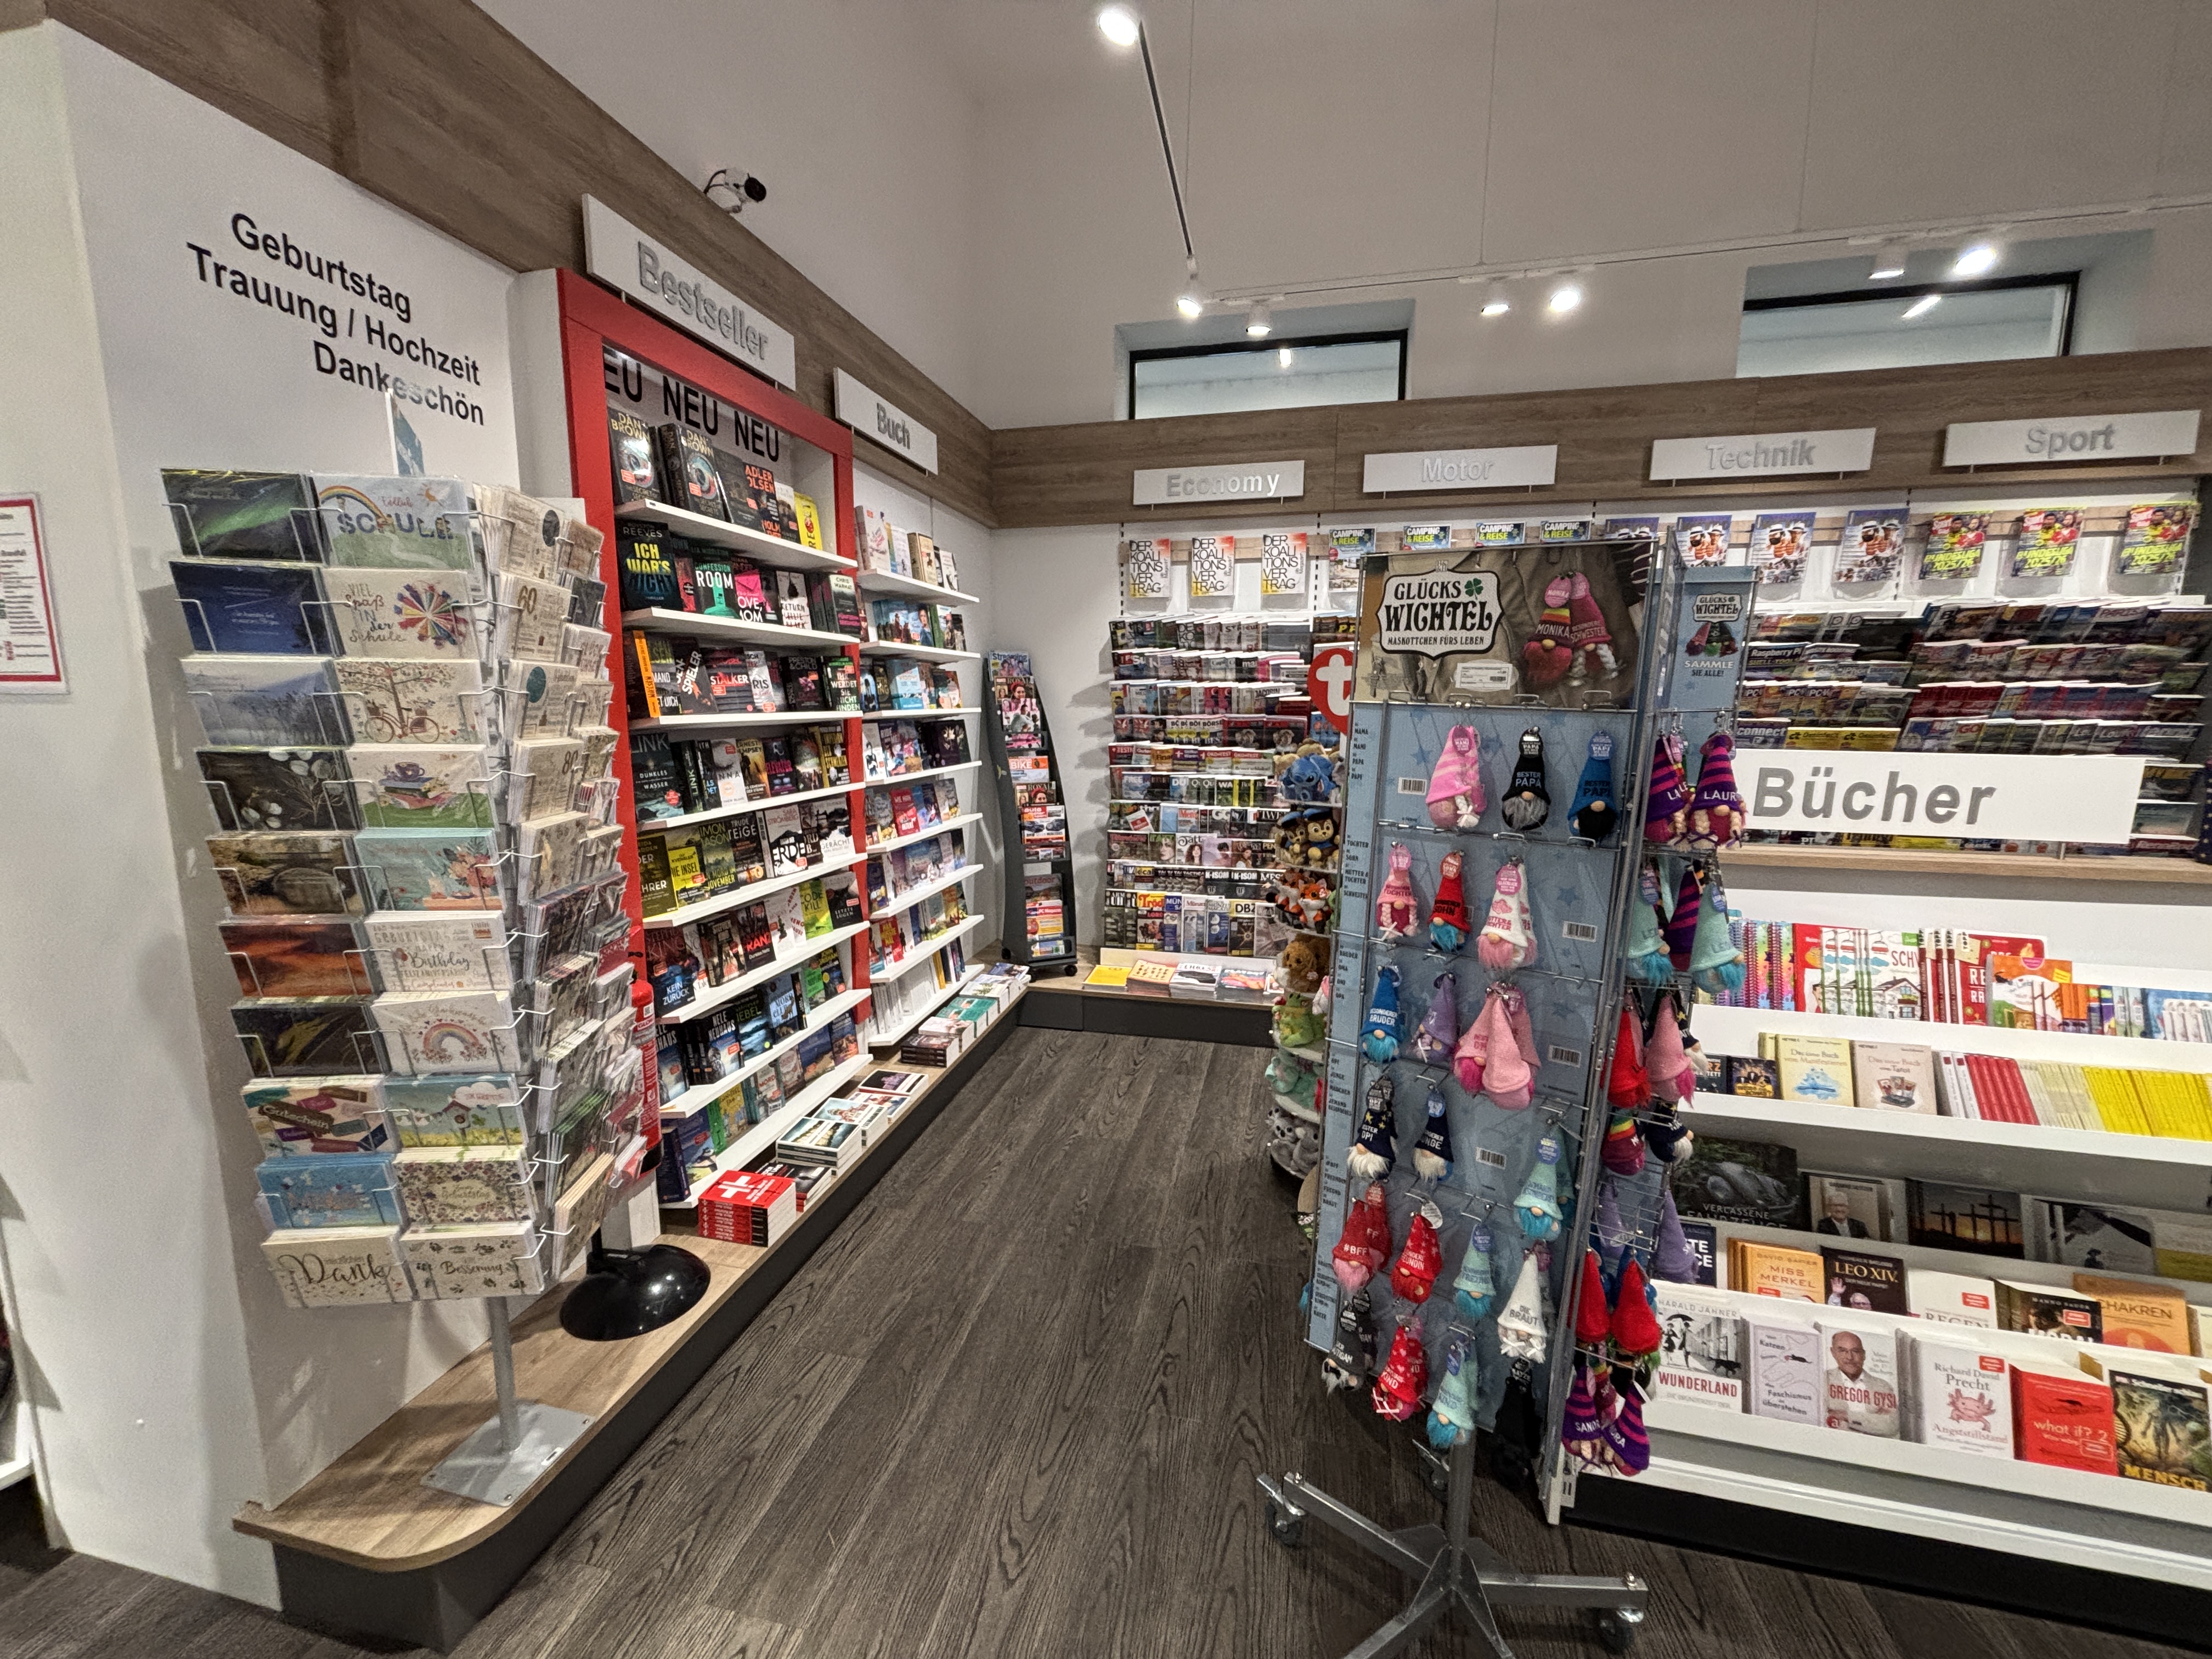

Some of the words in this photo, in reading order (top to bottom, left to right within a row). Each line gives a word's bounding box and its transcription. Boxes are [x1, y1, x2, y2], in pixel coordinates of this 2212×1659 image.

[232, 213, 411, 323] Geburtstag
[637, 238, 768, 360] Bestseller
[185, 242, 338, 338] Trauung
[347, 308, 356, 337] /
[365, 314, 480, 386] Hochzeit
[314, 340, 485, 426] Dankeschön
[618, 412, 641, 429] DAN
[663, 375, 719, 436] NEU
[734, 410, 779, 462] NEU
[611, 419, 651, 441] BROWN
[876, 402, 911, 450] Buch
[686, 430, 706, 445] DAN
[2024, 422, 2114, 456] Sport
[1705, 439, 1815, 472] Technik
[745, 465, 773, 484] ADLER
[1421, 457, 1494, 483] Motor
[1166, 472, 1280, 498] Economy
[623, 527, 663, 538] REEVES
[1407, 526, 1440, 536] CAMPING
[1479, 524, 1514, 534] CAMPING
[1544, 522, 1579, 531] CAMPING
[1333, 529, 1365, 538] CAMPING
[1413, 534, 1435, 543] REISE
[1486, 532, 1508, 540] REISE
[1551, 529, 1573, 538] REISE
[1130, 540, 1152, 551] DER
[1193, 538, 1216, 549] DER
[1263, 535, 1288, 546] DER
[1339, 537, 1359, 545] REISE
[634, 543, 660, 559] ICH
[1925, 549, 1980, 561] BUNDESLIGA
[2016, 546, 2074, 560] BUNDESLIGA
[2121, 543, 2182, 558] BUNDESLIGA
[627, 558, 672, 575] WAR'S
[1131, 561, 1163, 573] TIONS
[1193, 559, 1227, 571] TIONS
[1264, 556, 1299, 568] TIONS
[696, 570, 733, 590] ROOM
[1131, 573, 1153, 583] VER
[1193, 571, 1216, 582] VER
[1264, 568, 1287, 579] VER
[1131, 582, 1161, 594] TRAG
[1193, 580, 1224, 591] TRAG
[1263, 578, 1296, 589] TRAG
[1394, 578, 1462, 601] GLÜCKS
[345, 595, 385, 611] Spaß
[518, 585, 538, 614] 60
[1696, 604, 1739, 614] WICHTEL
[359, 610, 376, 623] IN
[1385, 601, 1493, 632] WICHTEL
[370, 622, 394, 633] der
[1537, 623, 1570, 638] MONIKA
[1570, 625, 1607, 643] SCHWESTER
[350, 628, 408, 642] Schule
[1387, 636, 1437, 646] MASKOTTCHEN
[1440, 635, 1458, 646] FÜRS
[1460, 636, 1485, 646] LEBEN
[992, 653, 1028, 663] Streaming
[1751, 648, 1793, 657] Raspberry
[1684, 660, 1734, 669] SAMMLE
[682, 651, 703, 695] SPIELER
[710, 674, 750, 686] STALKER
[831, 680, 857, 689] WERDET
[1737, 726, 1786, 737] connect
[1011, 761, 1032, 770] BIKE
[640, 769, 668, 779] DUNKLES
[644, 781, 669, 790] WASSER
[687, 769, 699, 797] LINK
[1515, 778, 1542, 788] PAPA
[1704, 790, 1737, 801] LAUR
[1753, 766, 1996, 826] Bücher
[731, 817, 749, 828] TRUDE
[1347, 840, 1369, 848] TOCHTER
[682, 862, 698, 876] INSEL
[1024, 877, 1056, 885] outdoor
[1384, 888, 1413, 898] TOCHTER
[805, 902, 820, 912] KILL
[1433, 906, 1457, 916] SOHN
[408, 951, 471, 972] Birthday
[667, 981, 684, 994] KEIN
[663, 988, 690, 1006] ZURÜCK
[713, 1010, 727, 1026] NELE
[1369, 1014, 1396, 1026] BRUDER
[708, 1020, 736, 1041] NEUHAUS
[1821, 1050, 1839, 1059] Buch
[1892, 1065, 1910, 1074] Tarot
[262, 1105, 331, 1130] Gutschein
[1361, 1131, 1373, 1142] OPI
[1703, 1202, 1770, 1220] VERLASSENE
[1344, 1243, 1368, 1256] #BFF
[277, 1252, 391, 1285] Dank
[442, 1261, 504, 1277] Besserung
[1769, 1265, 1805, 1277] MISS
[1835, 1261, 1867, 1278] LEO
[1870, 1265, 1899, 1284] XIV.
[1760, 1273, 1817, 1289] MERKEL
[1519, 1305, 1531, 1313] DIE
[1657, 1298, 1696, 1312] HARALD
[1509, 1310, 1540, 1325] BRAUT
[1759, 1339, 1786, 1351] Katzen
[1934, 1362, 1971, 1377] Richard
[1973, 1369, 2001, 1381] David
[1381, 1370, 1398, 1390] KIND
[1658, 1372, 1739, 1397] WUNDERLAND
[1945, 1373, 1991, 1391] Precht
[1768, 1389, 1813, 1401] Faschismus
[1829, 1384, 1871, 1405] GREGOR
[1874, 1391, 1898, 1408] GYSI
[1762, 1399, 1808, 1415] überstehen
[2033, 1419, 2071, 1436] what
[2073, 1426, 2093, 1438] if?
[2098, 1430, 2108, 1441] 2
